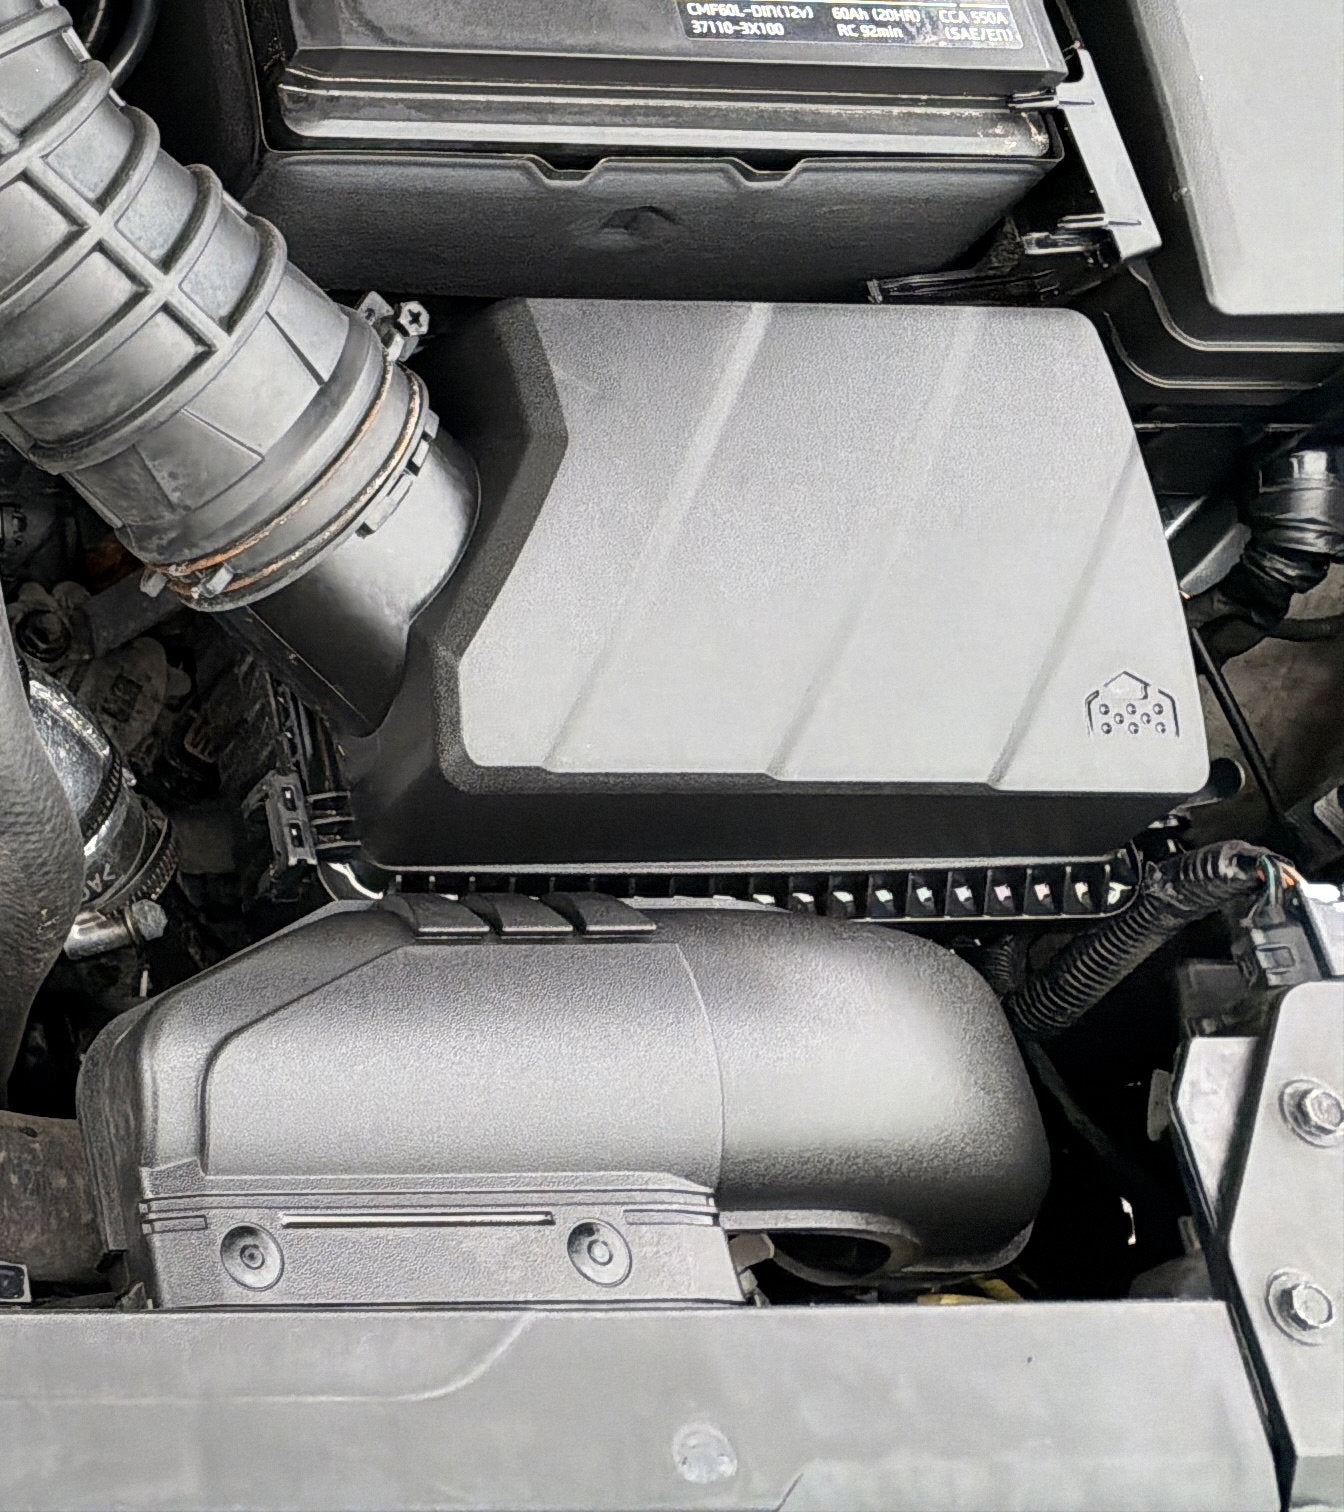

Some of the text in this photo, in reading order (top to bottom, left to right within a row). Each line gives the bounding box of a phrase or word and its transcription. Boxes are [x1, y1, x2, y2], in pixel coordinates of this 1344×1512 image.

[939, 9, 969, 24] CCA
[970, 10, 1009, 25] 550A
[837, 24, 859, 38] RC
[860, 25, 904, 39] 92min
